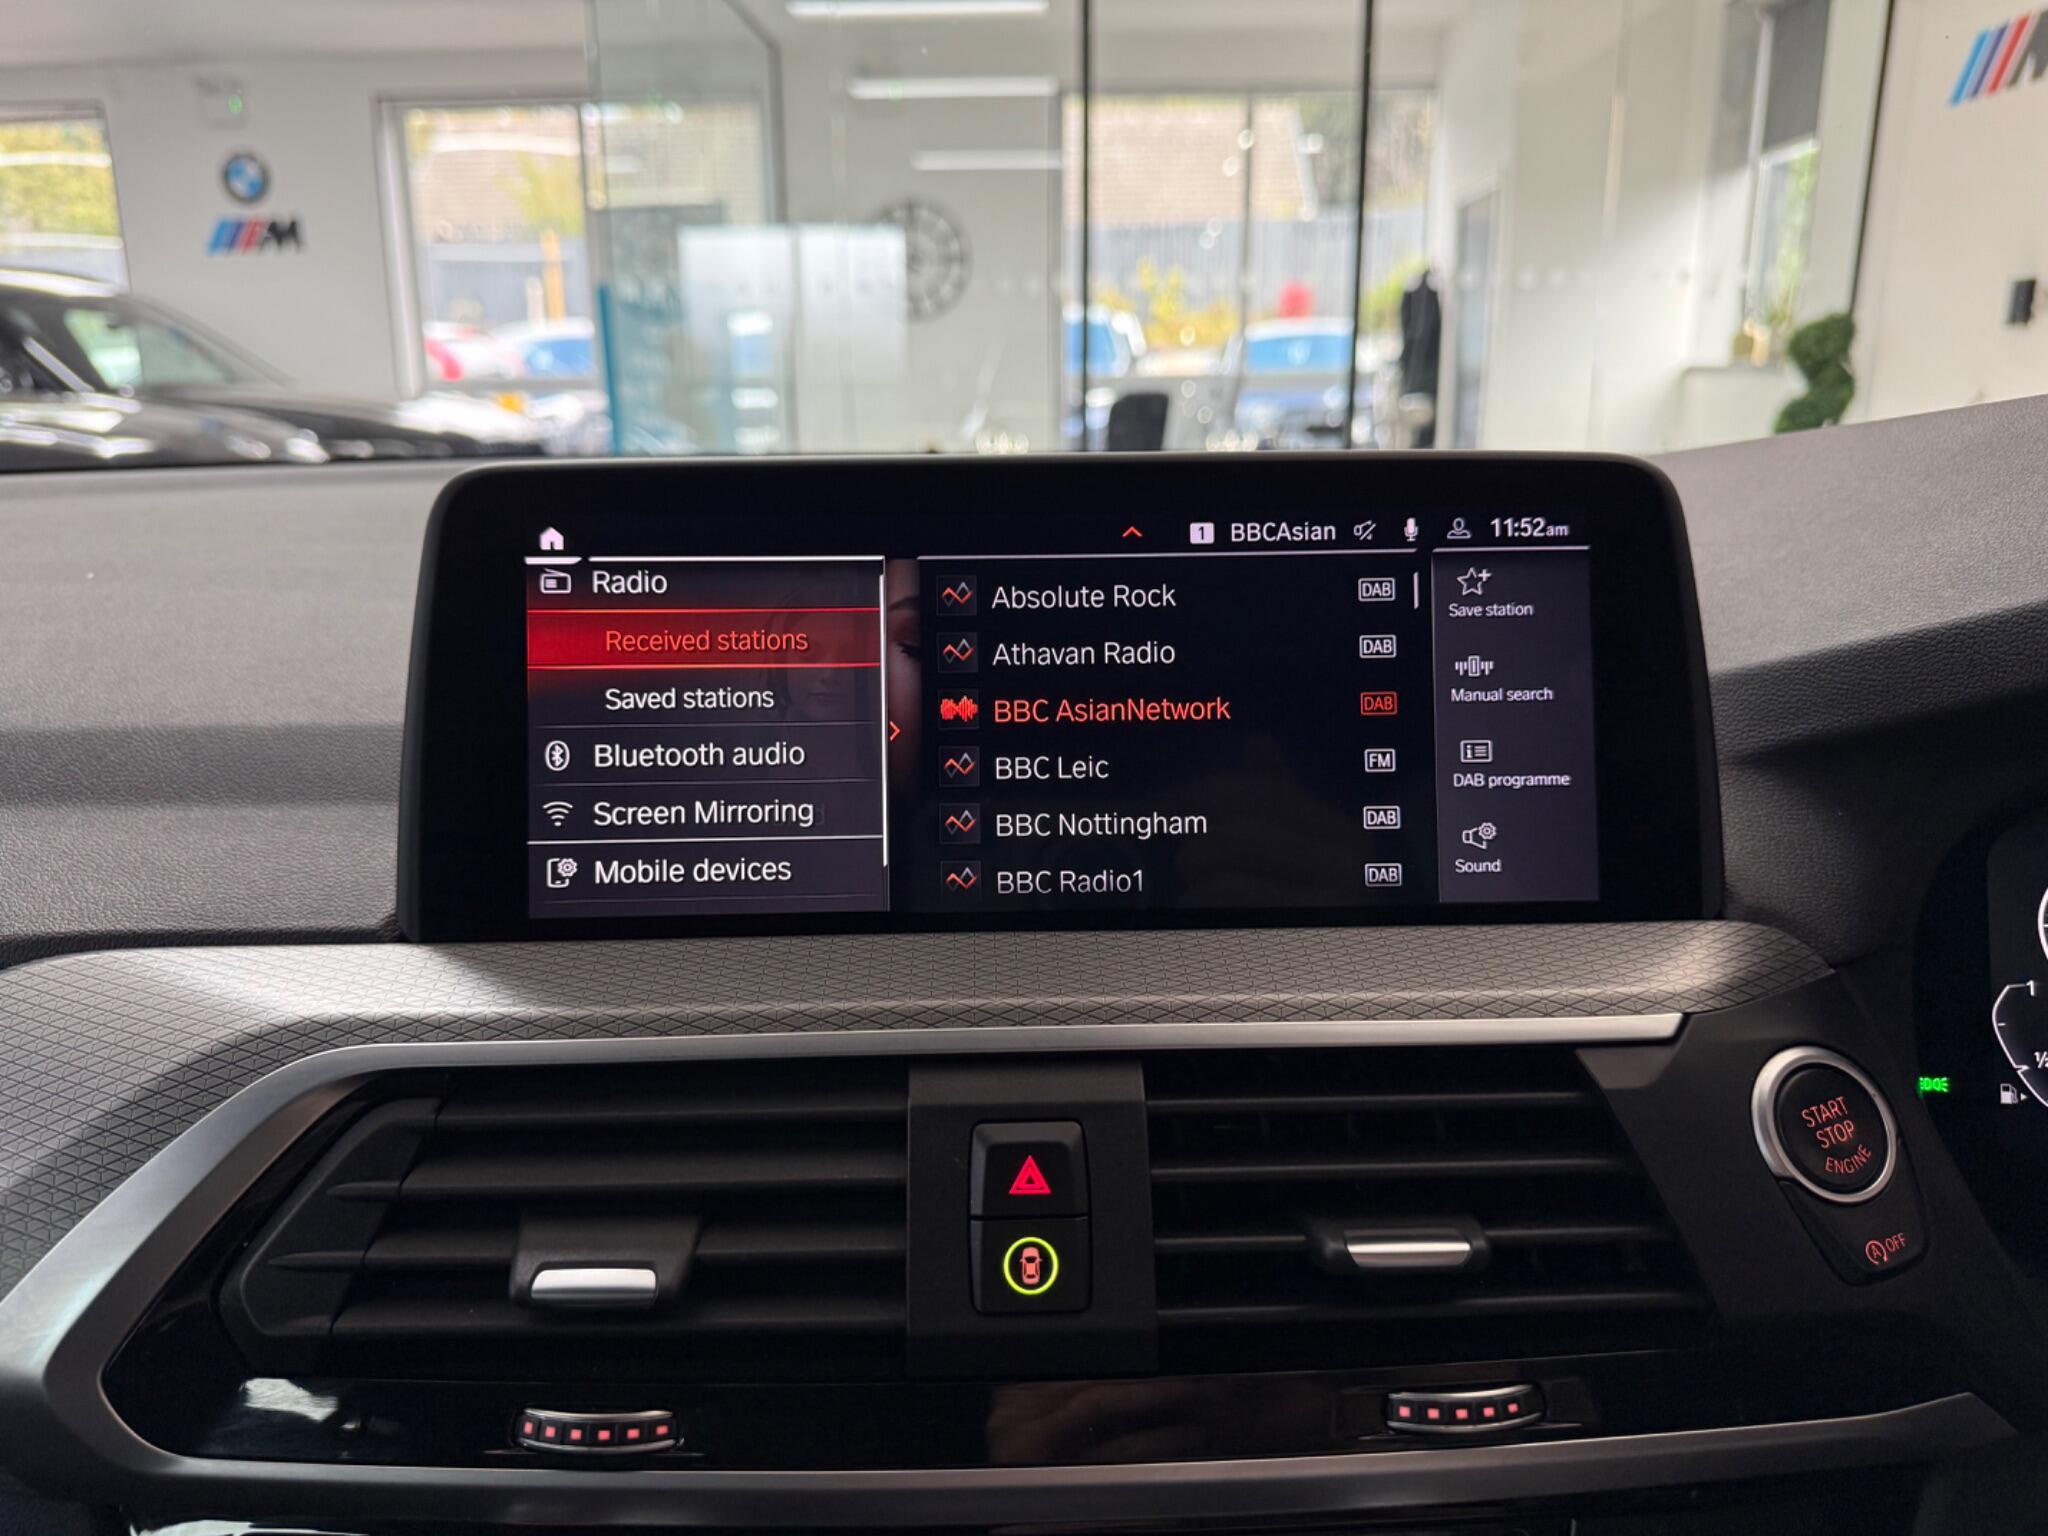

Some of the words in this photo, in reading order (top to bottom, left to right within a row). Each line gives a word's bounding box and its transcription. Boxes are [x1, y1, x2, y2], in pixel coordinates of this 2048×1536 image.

[1230, 521, 1337, 543] BBCAsian
[591, 570, 668, 594] Radio
[1361, 581, 1393, 598] DAB
[992, 585, 1105, 609] Absolute
[1113, 584, 1177, 607] Rock
[1448, 602, 1483, 617] Save
[1486, 601, 1534, 616] station
[604, 630, 711, 652] Received
[717, 630, 809, 651] stations
[992, 641, 1096, 665] Athavan
[1103, 640, 1176, 664] Radio
[1362, 638, 1394, 655] DAB
[605, 687, 677, 710] Saved
[683, 686, 775, 708] stations
[1363, 695, 1395, 711] DAB
[1450, 688, 1503, 703] Manual
[1507, 687, 1554, 701] search
[993, 700, 1050, 722] BBC
[1056, 697, 1232, 721] AsianNetwork
[594, 742, 725, 768] Bluetooth
[732, 742, 806, 766] audio
[1369, 753, 1391, 769] FM
[995, 757, 1051, 779] BBC
[1057, 756, 1110, 778] Leic
[1453, 773, 1485, 787] DAB
[1488, 772, 1571, 788] programme
[593, 801, 686, 826] Screen
[695, 800, 815, 827] Mirroring
[996, 814, 1051, 837] BBC
[1058, 812, 1208, 838] Nottingham
[1366, 809, 1398, 826] DAB
[594, 859, 686, 884] Mobile
[693, 857, 792, 882] devices
[1368, 866, 1399, 883] DAB
[1455, 859, 1502, 873] Sound
[997, 871, 1052, 894] BBC
[1060, 870, 1145, 893] Radio1
[1801, 1096, 1849, 1128] START
[1816, 1120, 1855, 1149] STOP
[1824, 1143, 1873, 1175] ENGINE
[1884, 1232, 1907, 1253] OFF
